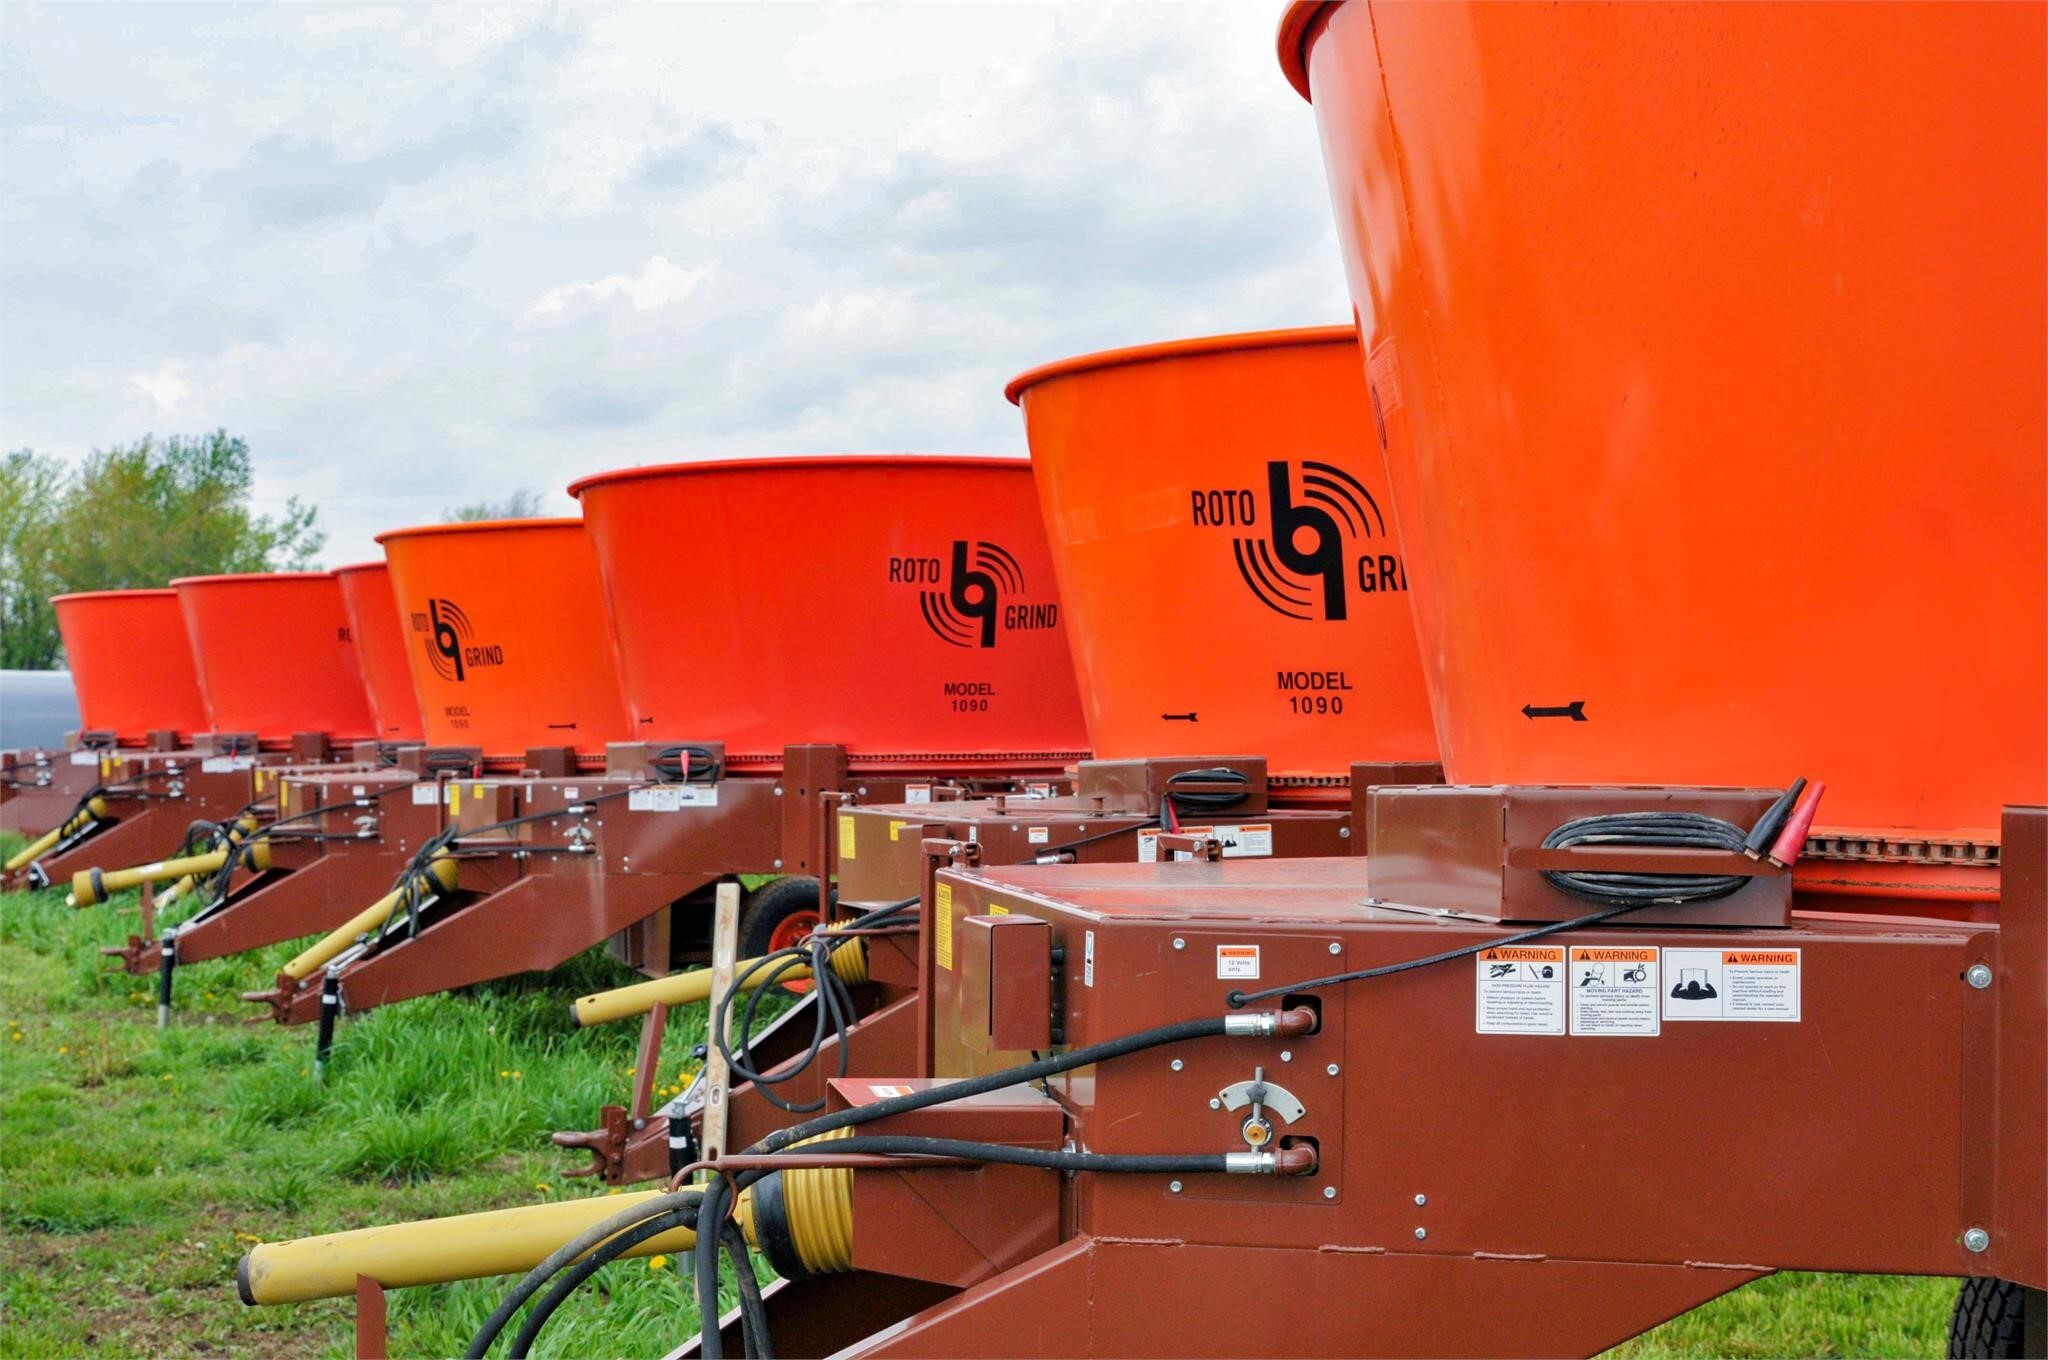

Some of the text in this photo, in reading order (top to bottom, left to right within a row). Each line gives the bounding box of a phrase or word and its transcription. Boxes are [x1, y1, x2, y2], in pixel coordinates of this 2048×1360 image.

[1192, 490, 1255, 526] ROTO
[889, 558, 940, 583] ROTO
[1005, 604, 1058, 630] GRIND
[465, 645, 504, 667] GRIND
[944, 683, 995, 696] MODEL
[1277, 672, 1353, 690] MODEL
[952, 699, 988, 712] 1090
[1290, 696, 1343, 714] 1090
[1500, 950, 1556, 960] WARNING
[1594, 951, 1648, 960] WARNING
[1741, 954, 1793, 963] WARNING
